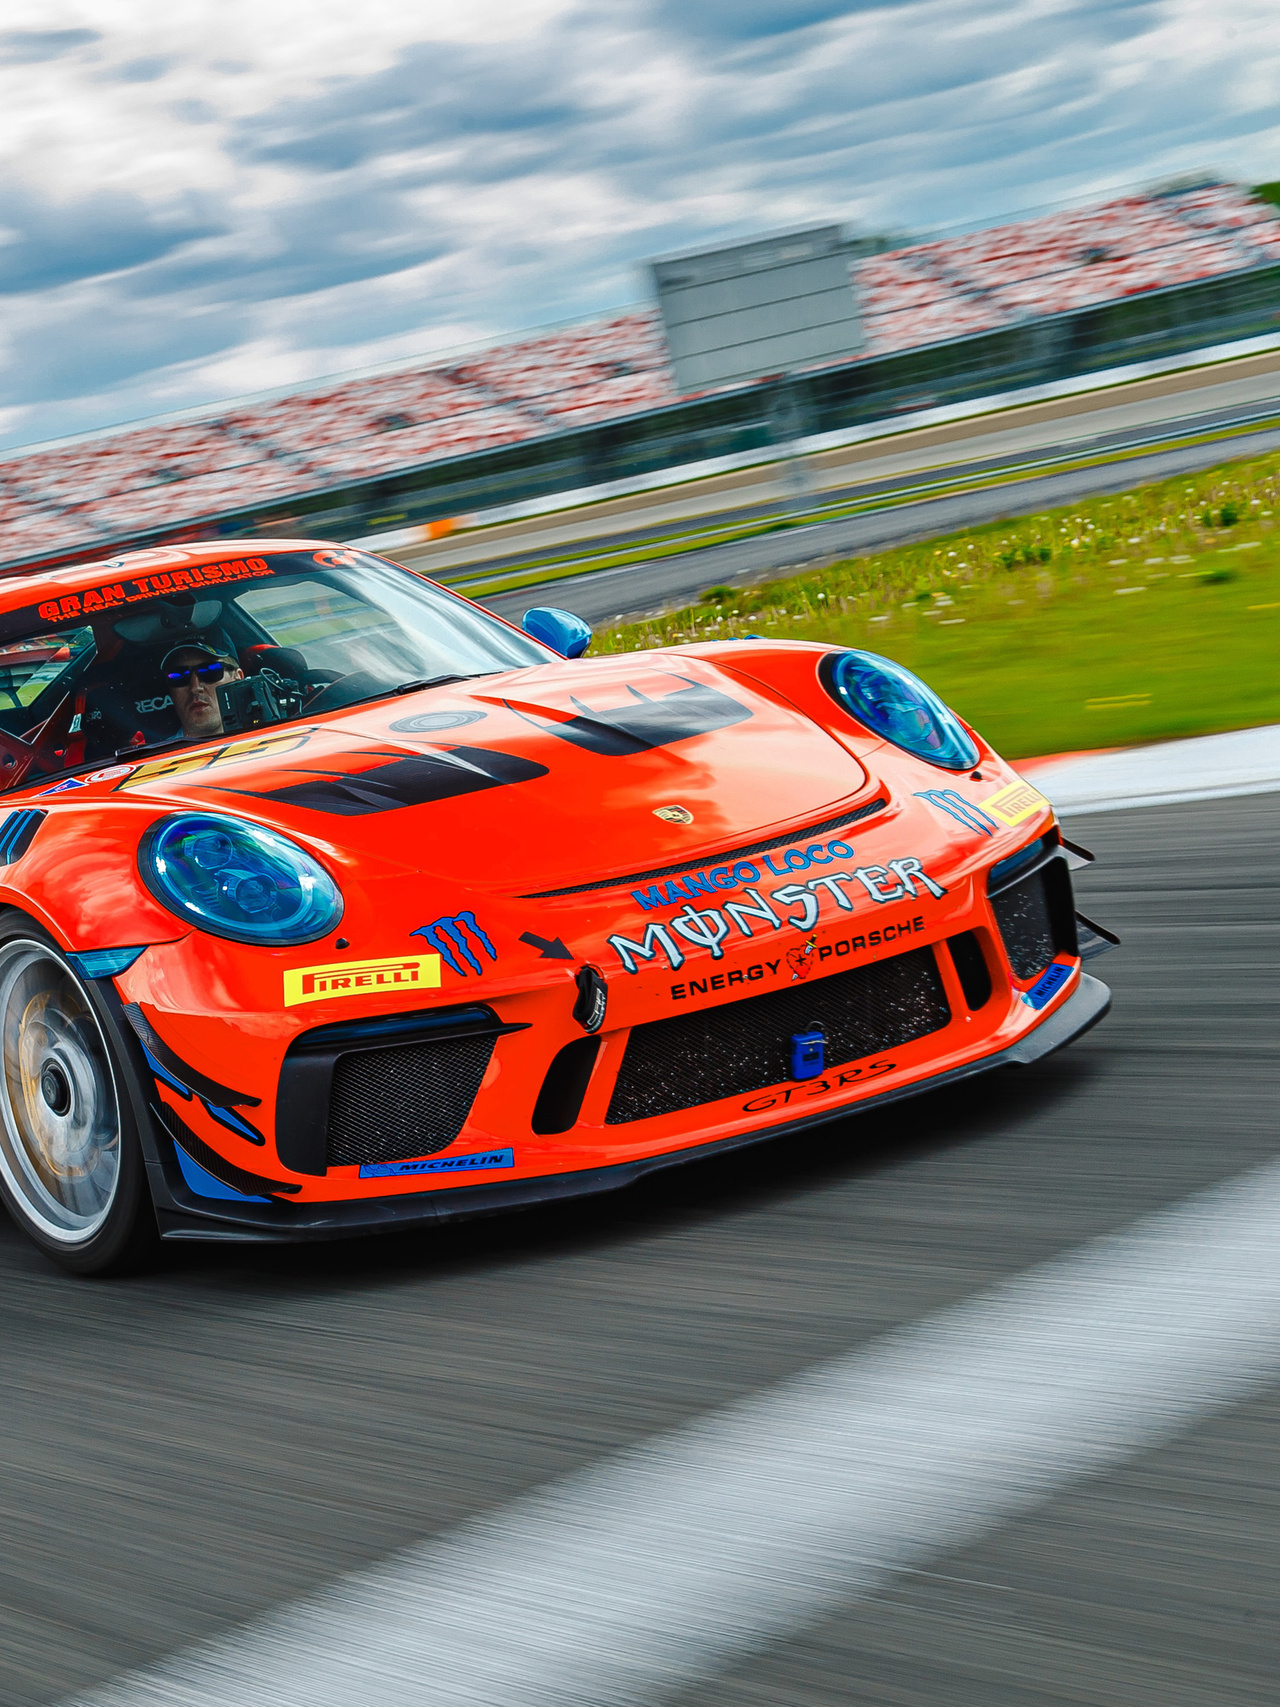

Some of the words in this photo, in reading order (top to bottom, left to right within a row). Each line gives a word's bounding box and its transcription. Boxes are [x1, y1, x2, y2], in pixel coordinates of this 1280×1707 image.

[38, 584, 126, 619] GRAN
[132, 558, 269, 593] TURISMO
[47, 610, 80, 623] THE
[82, 600, 124, 614] REAL
[125, 583, 190, 601] DRIVING
[191, 569, 275, 588] SIMULATOR
[135, 694, 174, 714] RECA
[631, 861, 761, 911] MANGO
[762, 839, 855, 878] LOCO
[302, 961, 421, 995] PIRELLI
[670, 959, 782, 1000] ENERGY
[818, 916, 926, 962] PORSCHE
[742, 1059, 897, 1113] GT3RS
[399, 1154, 505, 1173] MICHELIN
